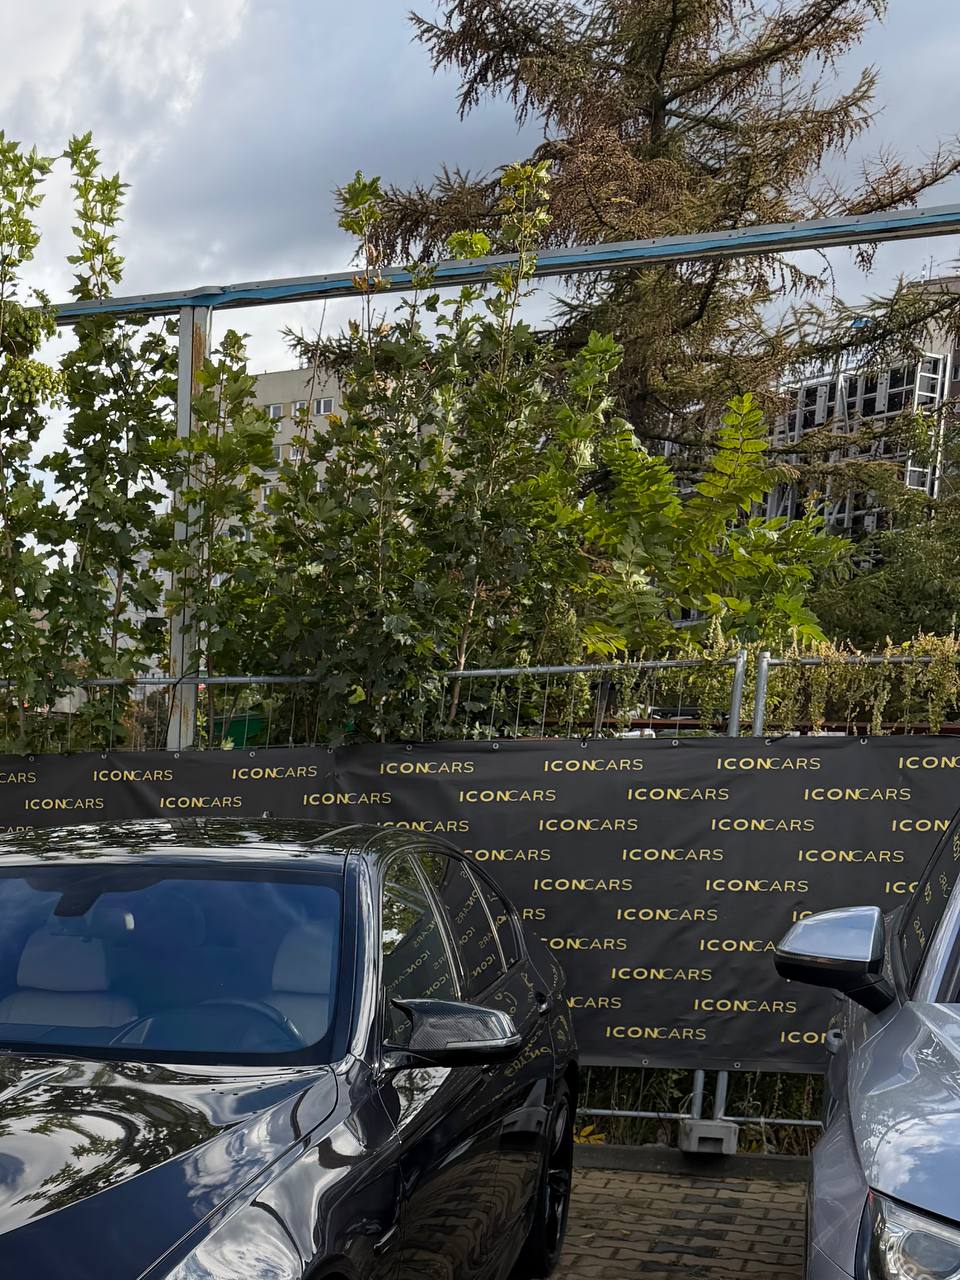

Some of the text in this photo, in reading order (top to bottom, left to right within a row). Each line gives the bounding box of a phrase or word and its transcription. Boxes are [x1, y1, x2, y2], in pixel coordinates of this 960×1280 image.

[380, 761, 475, 774] ICONCARS
[543, 758, 644, 772] ICONCARS
[716, 757, 821, 770] ICONCARS
[93, 769, 173, 781] ICONCARS
[232, 765, 318, 779] ICONCARS
[303, 792, 392, 805] ICONCARS
[459, 790, 556, 803] ICONCARS
[627, 788, 729, 801] ICONCARS
[804, 787, 911, 801] ICONCARS
[24, 797, 104, 810] ICONCARS
[159, 796, 242, 809] ICONCARS
[539, 818, 638, 832] ICONCARS
[711, 818, 814, 831] ICONCARS
[622, 848, 723, 861] ICONCARS
[798, 849, 905, 862] ICONCARS
[533, 878, 632, 892] ICONCARS
[705, 879, 809, 892] ICONCARS
[616, 908, 718, 921] ICONCARS
[611, 968, 712, 981] ICONCARS
[694, 999, 797, 1014] ICONCARS
[606, 1026, 707, 1040] ICONCARS
